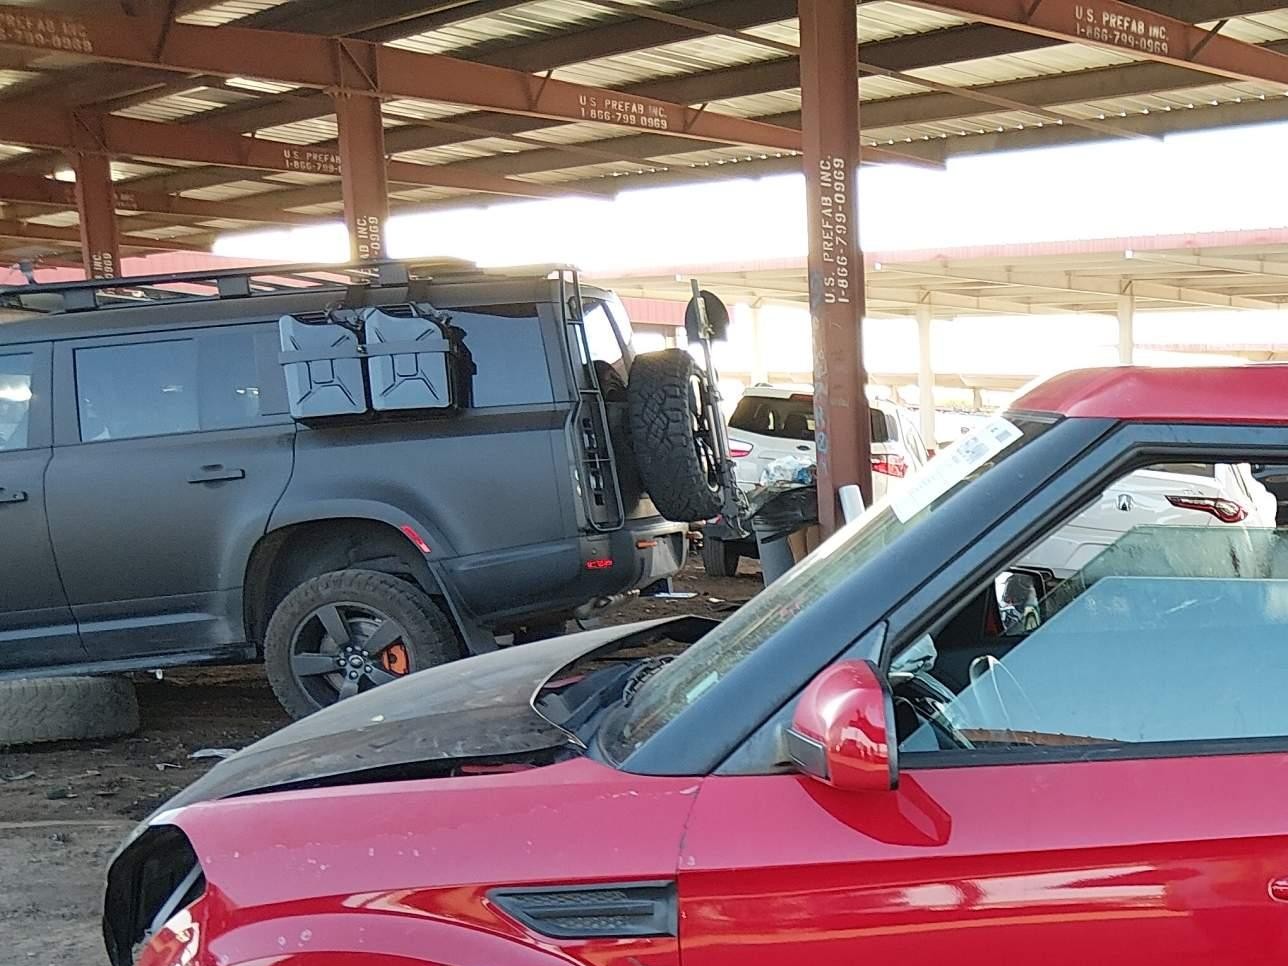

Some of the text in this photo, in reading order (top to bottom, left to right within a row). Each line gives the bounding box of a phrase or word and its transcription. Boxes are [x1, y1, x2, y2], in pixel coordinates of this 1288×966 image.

[1102, 11, 1145, 35] PREFAB
[604, 98, 645, 115] PREFAB
[820, 155, 832, 187] INC.
[821, 196, 835, 262] PREFAB
[833, 158, 850, 304] 1-866-799-0969
